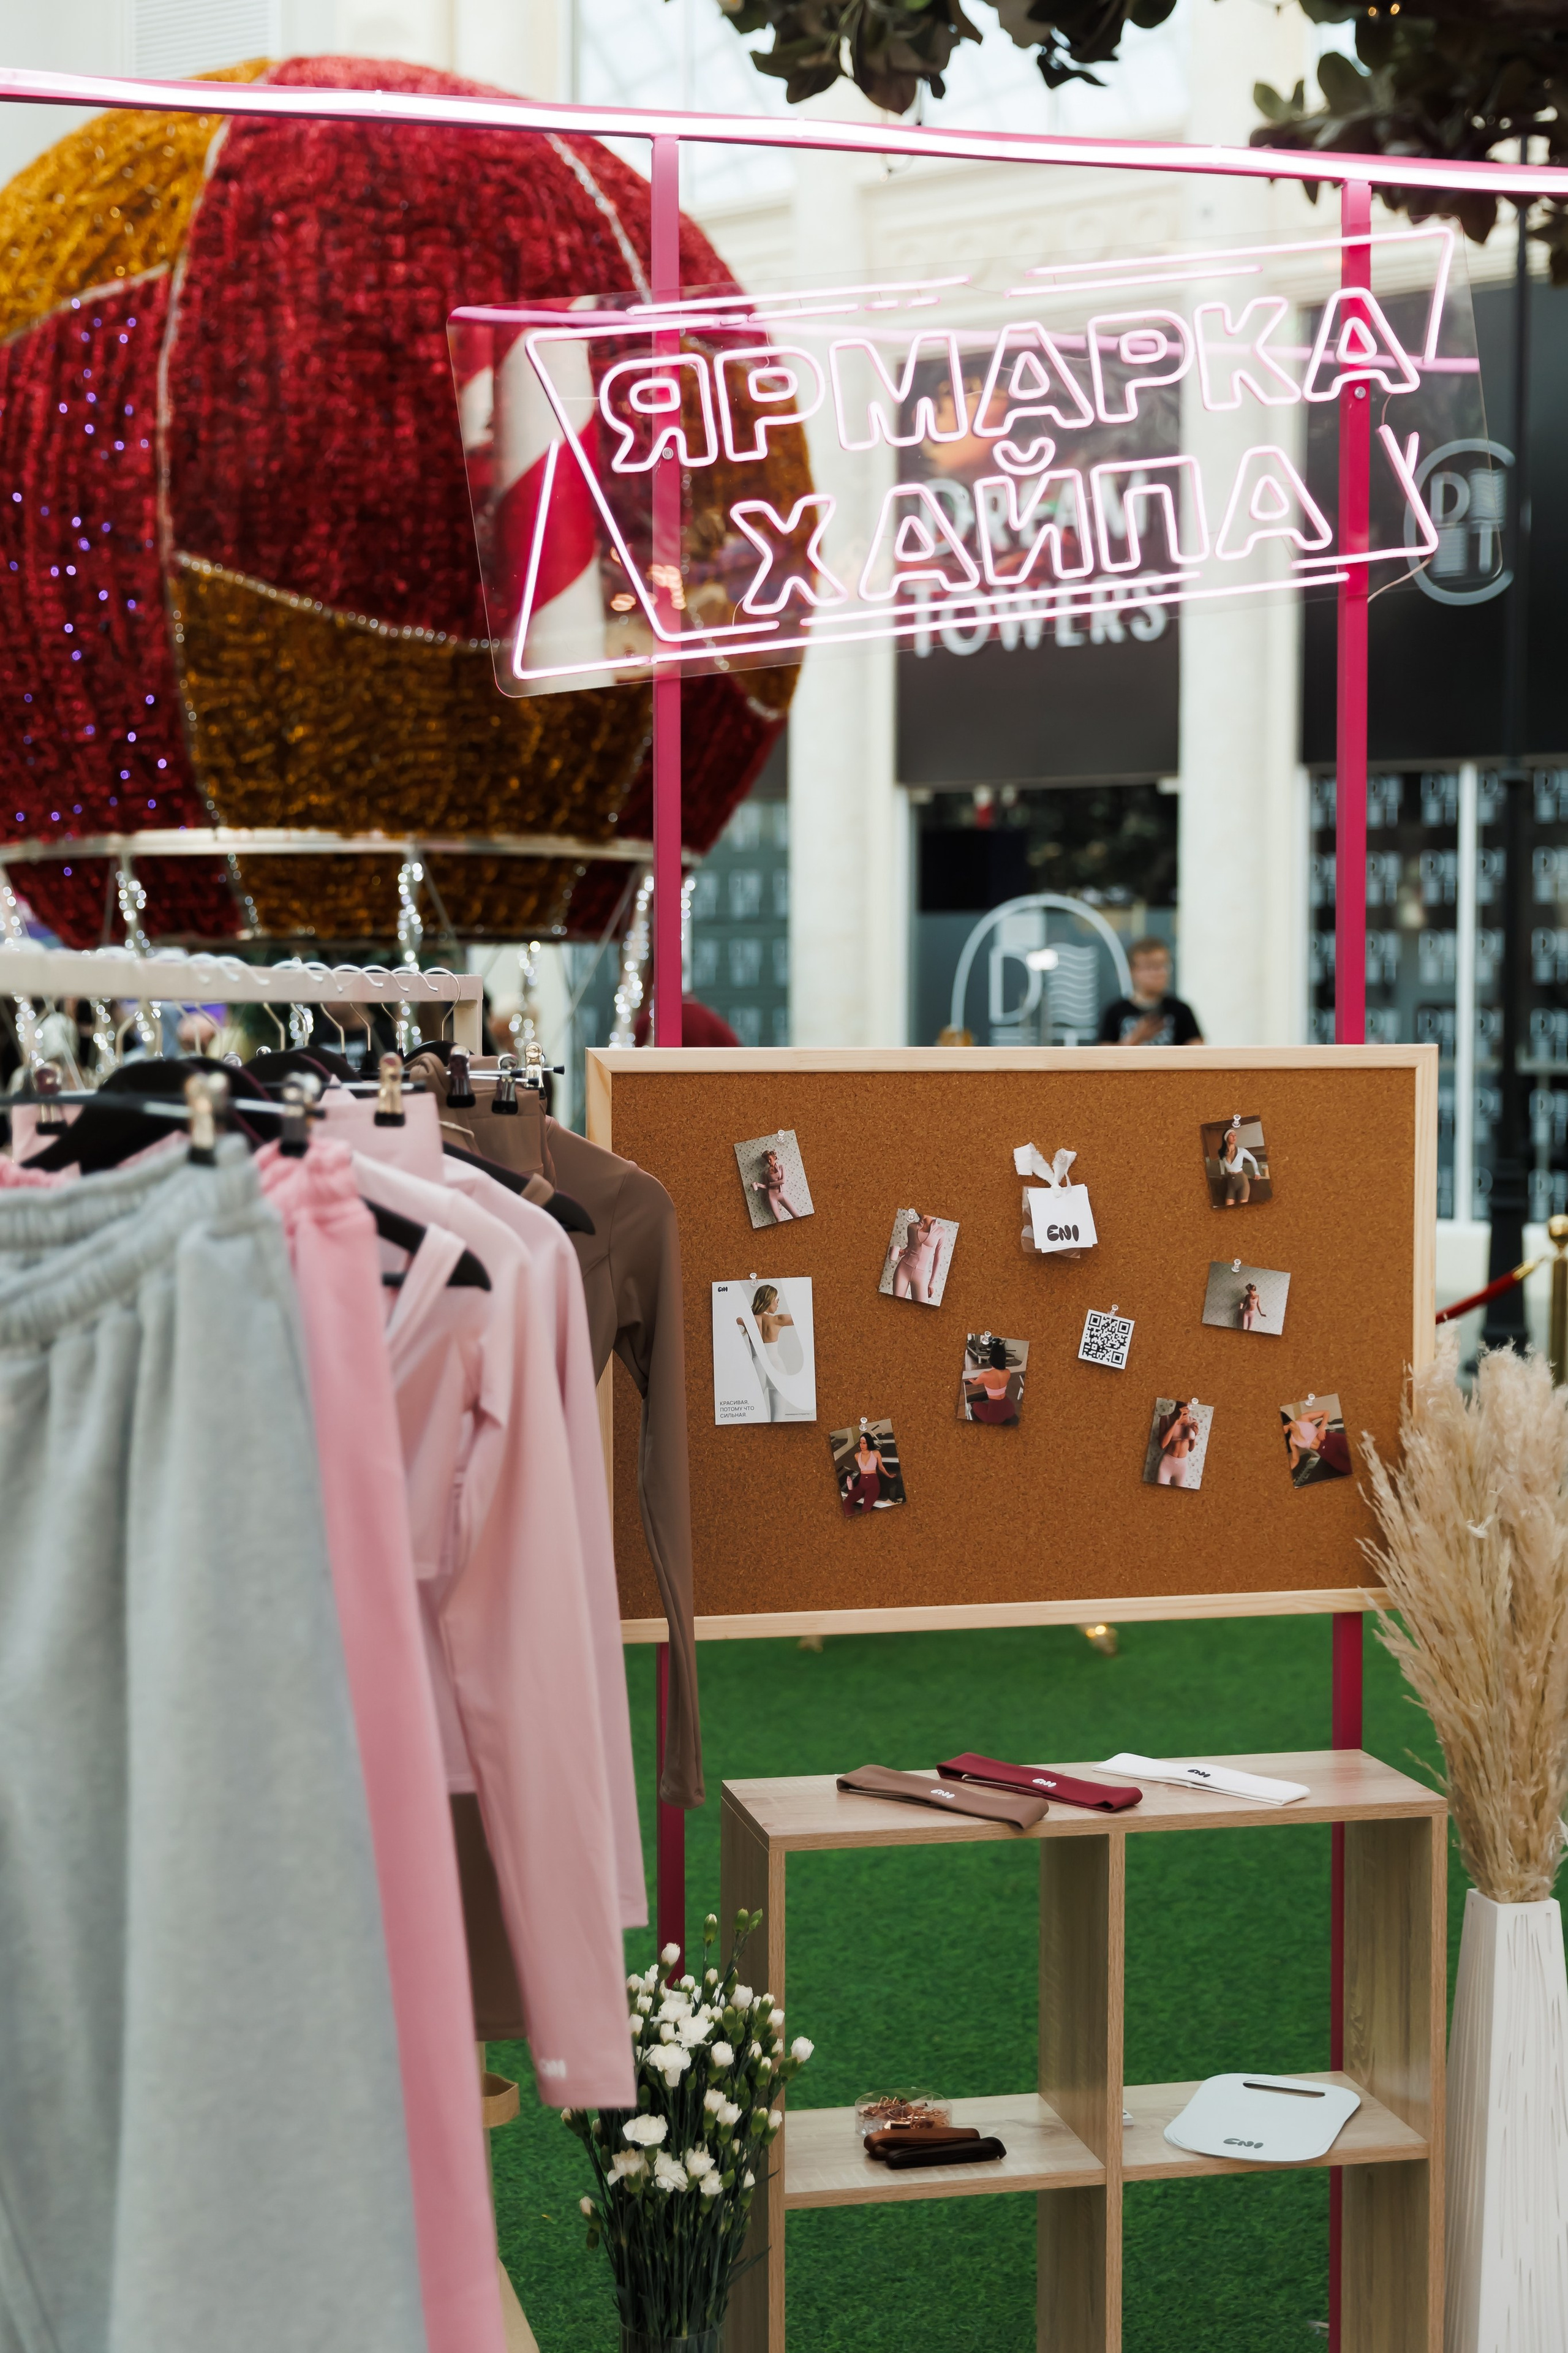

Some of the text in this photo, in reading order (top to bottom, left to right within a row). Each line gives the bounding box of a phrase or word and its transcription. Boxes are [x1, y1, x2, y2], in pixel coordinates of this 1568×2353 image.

[600, 287, 1420, 473] ЯРМАРКА
[731, 437, 1333, 616] ХАЙПА
[919, 470, 1148, 556] DREAM
[903, 570, 1167, 658] TOWERS
